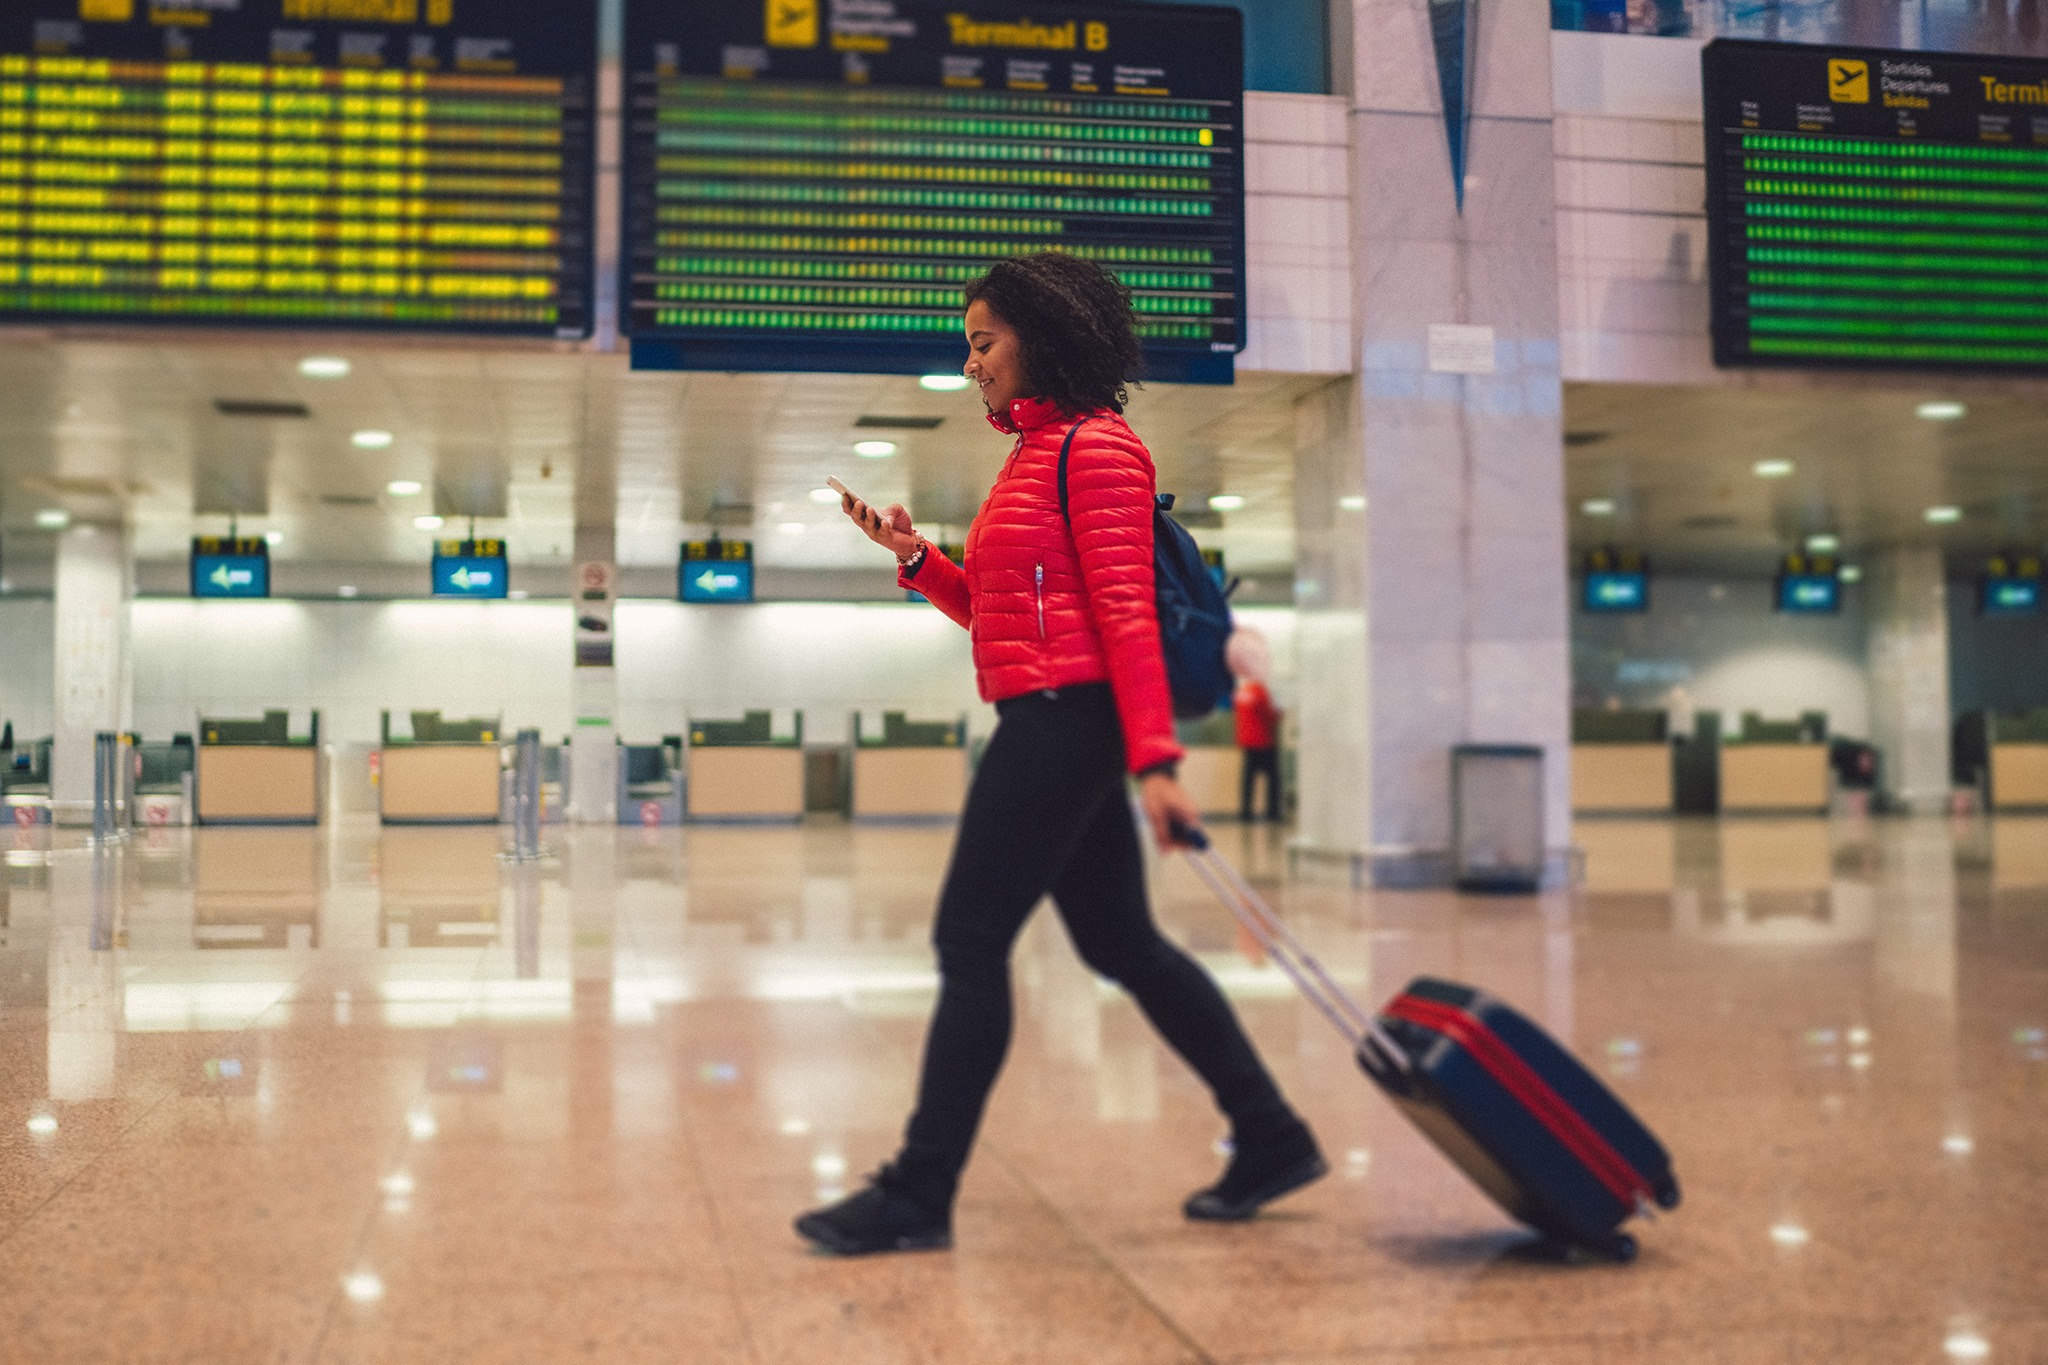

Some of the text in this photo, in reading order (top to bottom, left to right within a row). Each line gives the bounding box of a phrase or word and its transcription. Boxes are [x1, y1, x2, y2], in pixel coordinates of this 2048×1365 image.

[947, 13, 1076, 49] Terminal
[1084, 22, 1107, 50] B
[1881, 76, 1949, 95] Departures
[1883, 92, 1929, 109] Salidas
